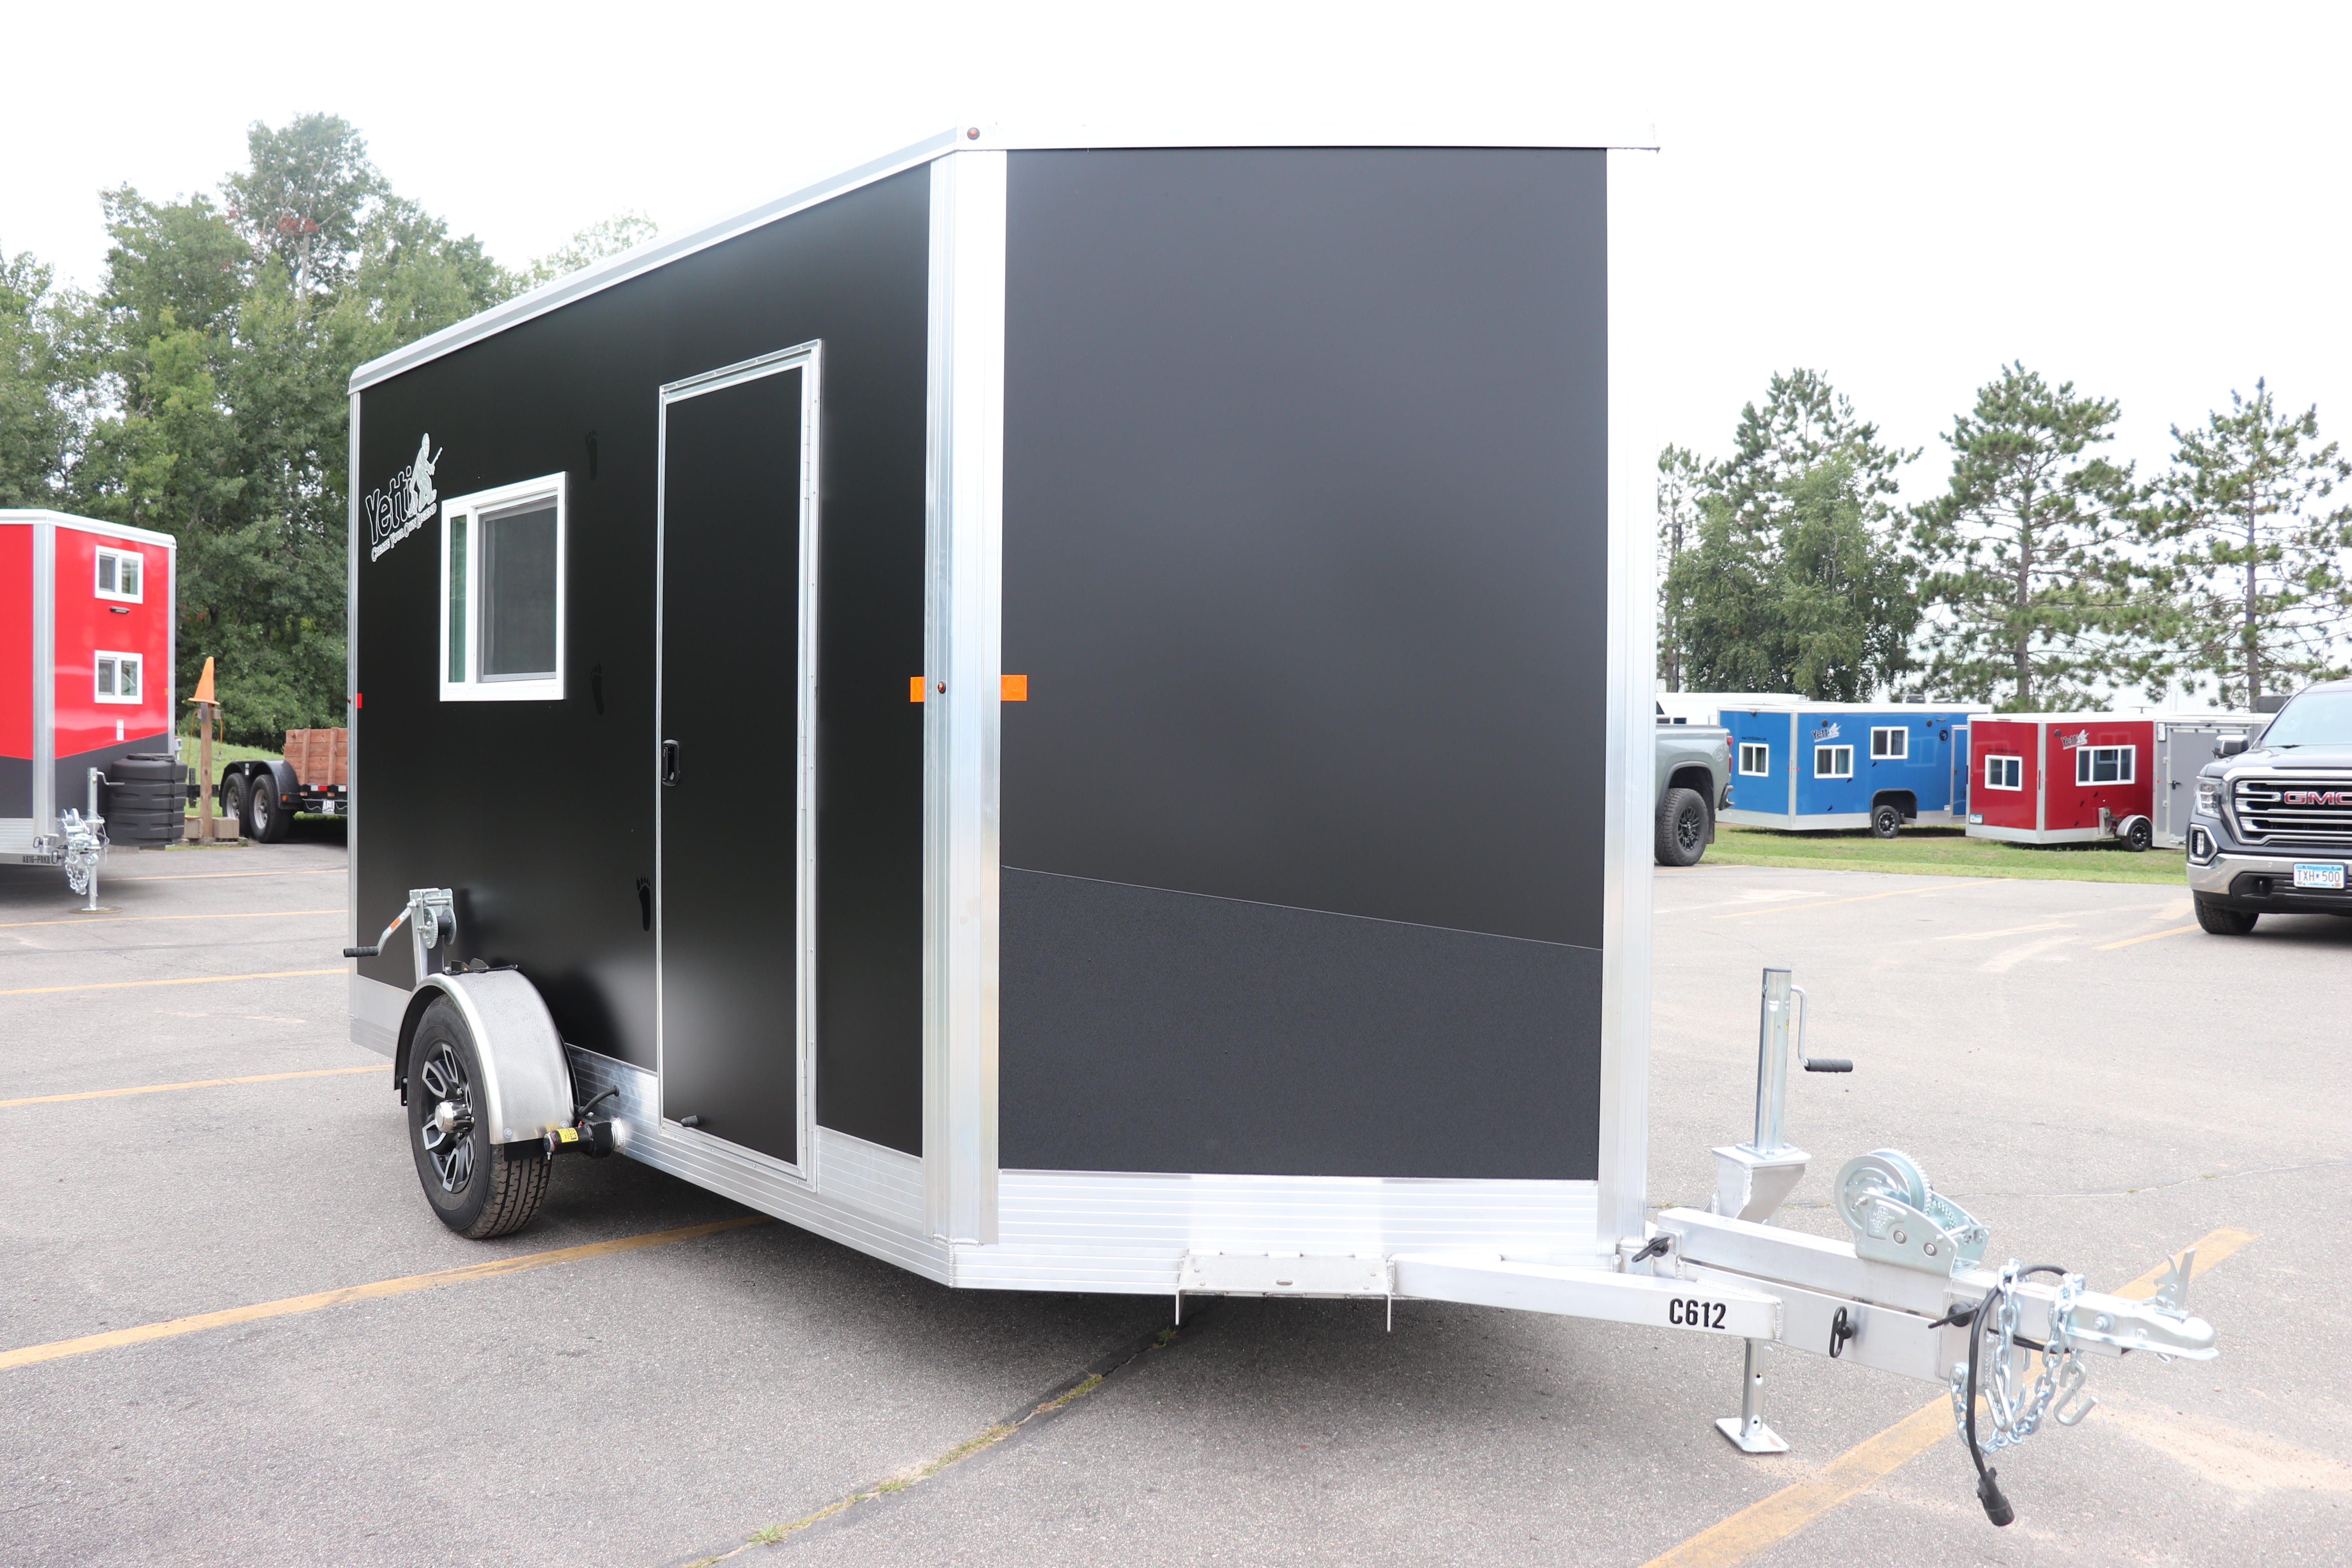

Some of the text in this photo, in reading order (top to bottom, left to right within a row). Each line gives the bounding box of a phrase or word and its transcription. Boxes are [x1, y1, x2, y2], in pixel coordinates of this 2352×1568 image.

[365, 466, 412, 545] Yetti
[389, 528, 405, 549] YOUR
[404, 517, 417, 538] OWN
[416, 503, 437, 529] LEGEND
[2284, 791, 2352, 805] GMC
[2297, 870, 2340, 882] TXH 500
[1669, 1298, 1726, 1329] C612
